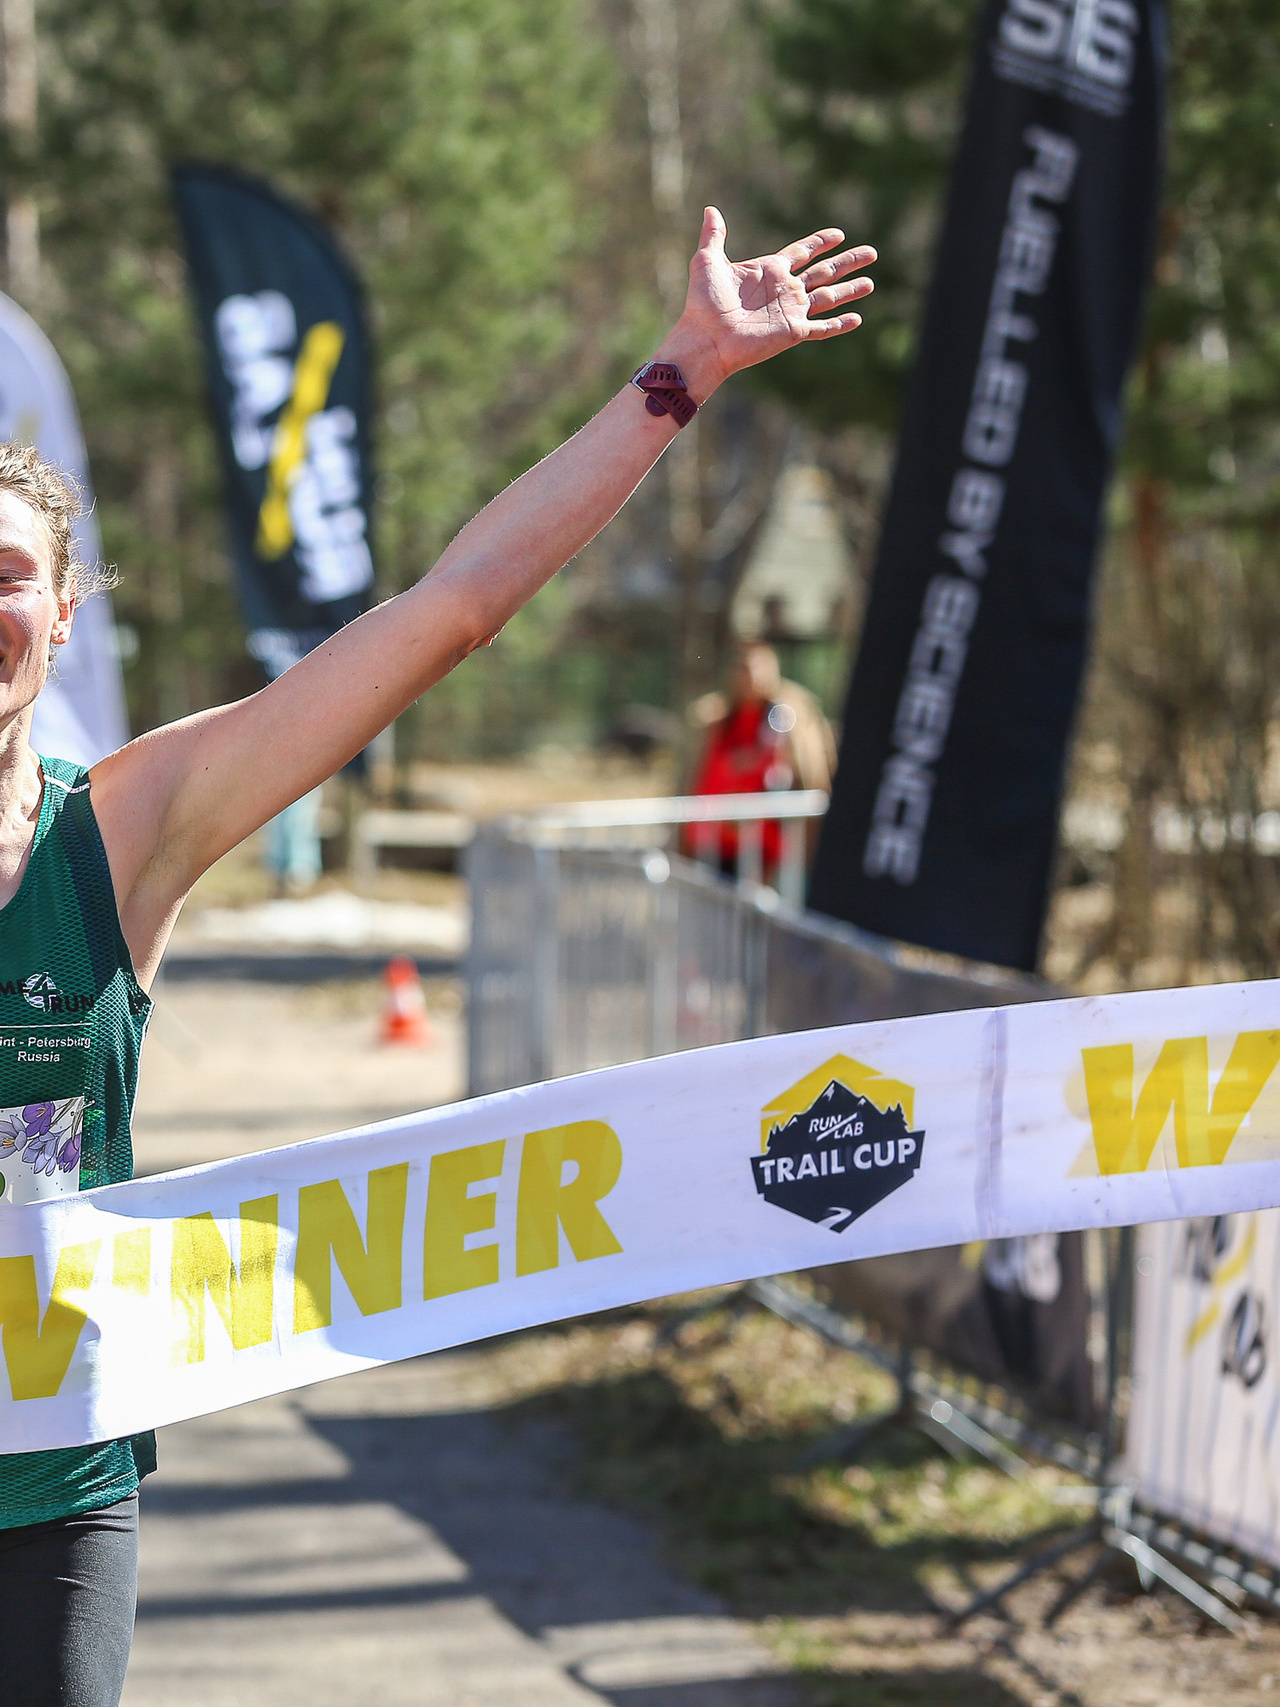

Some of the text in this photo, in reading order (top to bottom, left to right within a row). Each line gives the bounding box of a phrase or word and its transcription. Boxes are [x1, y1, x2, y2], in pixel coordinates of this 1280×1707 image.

[963, 125, 1079, 466] FUELLED
[938, 468, 1006, 580] BY
[862, 573, 981, 886] SCIENCE
[17, 1050, 61, 1063] Russia
[27, 1035, 91, 1050] Petersburg
[808, 1114, 842, 1134] RUN
[833, 1121, 865, 1140] LAB
[758, 1137, 917, 1186] TRAIL CUP
